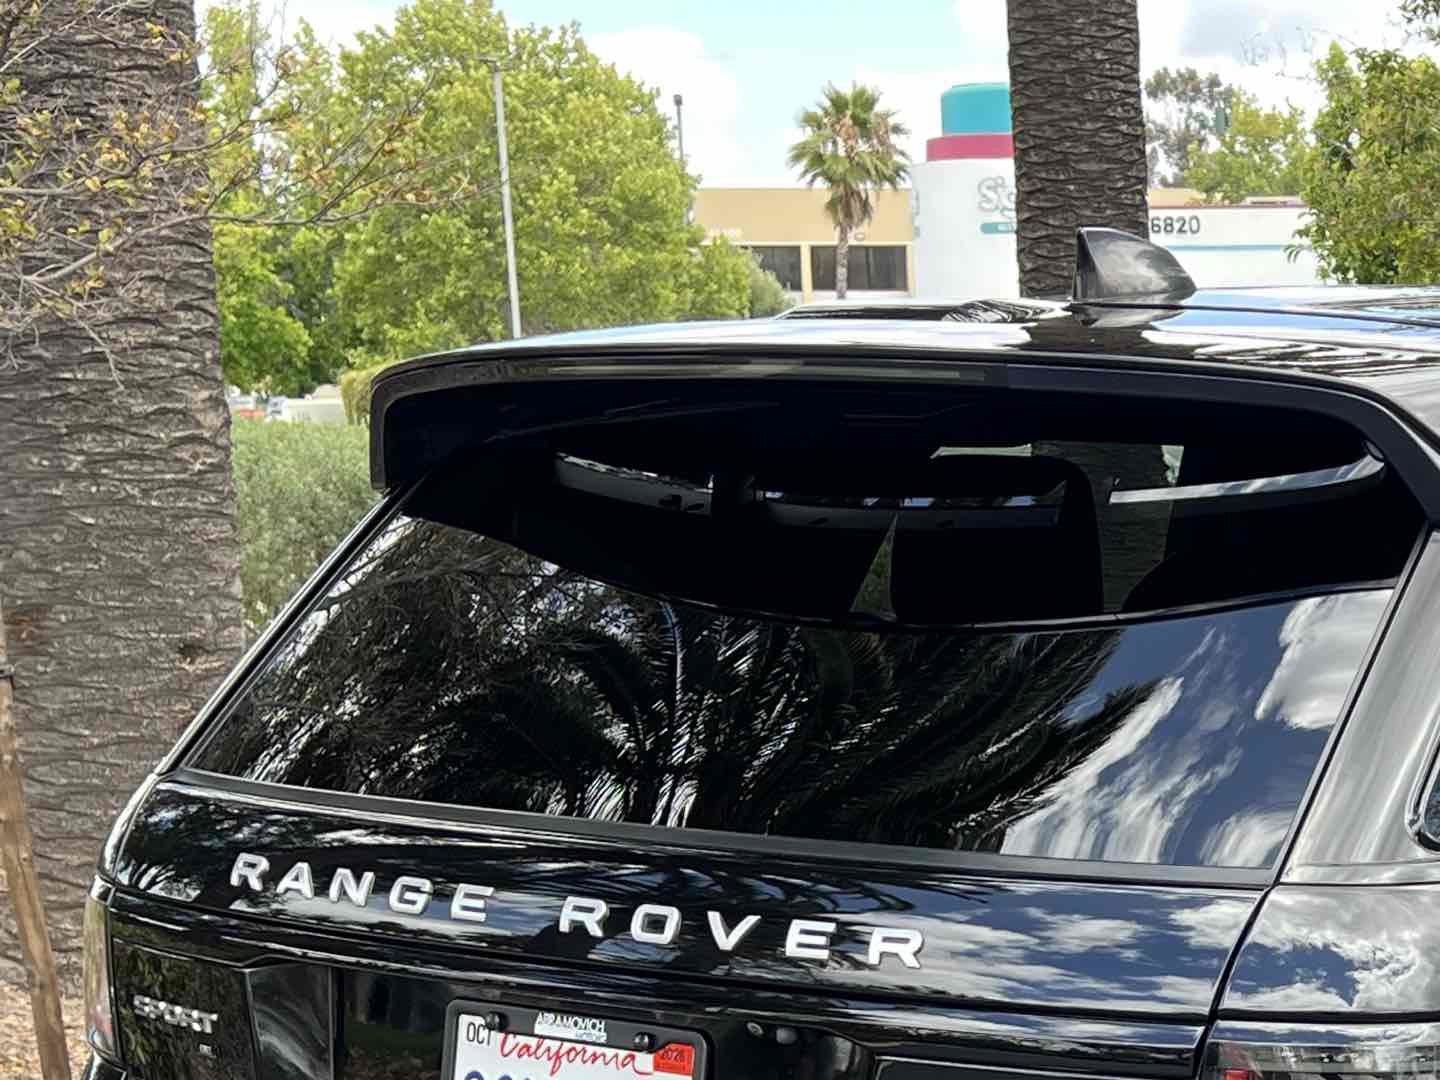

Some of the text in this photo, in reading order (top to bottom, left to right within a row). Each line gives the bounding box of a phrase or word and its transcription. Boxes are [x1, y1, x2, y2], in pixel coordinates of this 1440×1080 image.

[1151, 215, 1200, 234] 6820
[229, 852, 925, 970] RANGE ROVER
[133, 994, 218, 1034] SPORT
[466, 1022, 492, 1046] OCT
[500, 1032, 653, 1077] California
